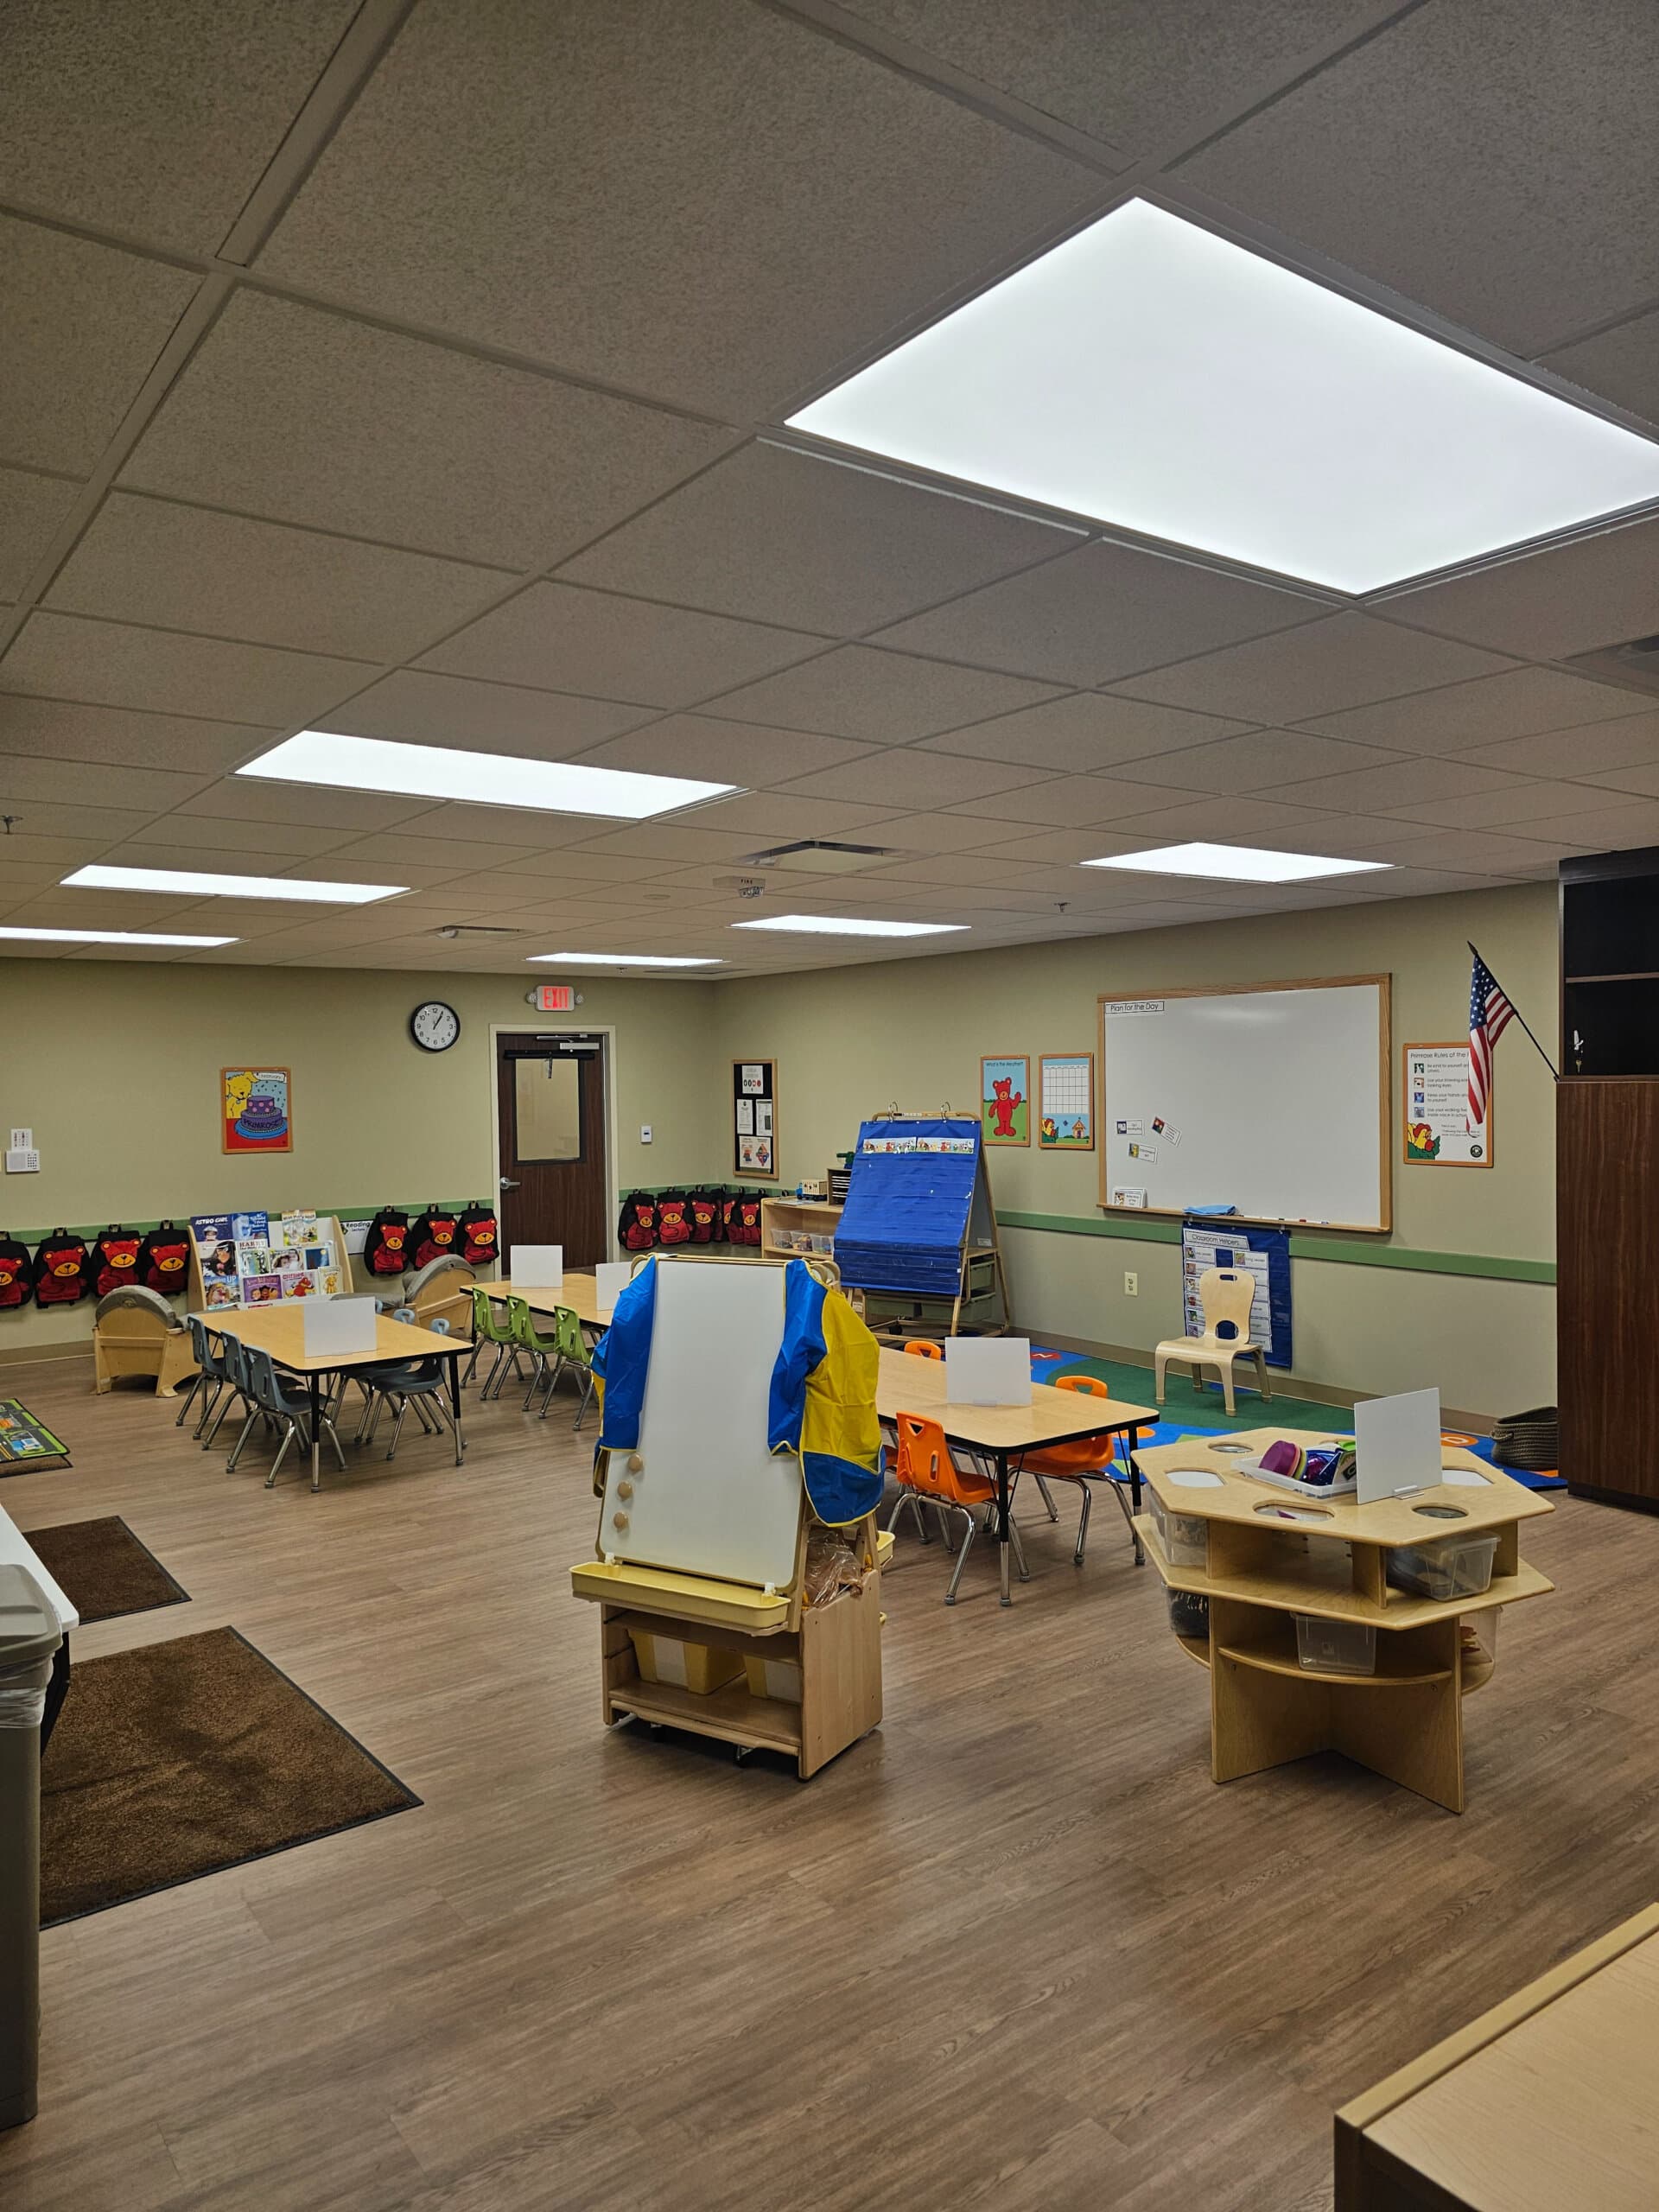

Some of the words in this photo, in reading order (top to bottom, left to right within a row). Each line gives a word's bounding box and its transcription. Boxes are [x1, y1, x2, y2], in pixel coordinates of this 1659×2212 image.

[543, 987, 569, 1009] EXIT
[1192, 1234, 1218, 1244] Classroom
[1218, 1236, 1239, 1246] Helpers
